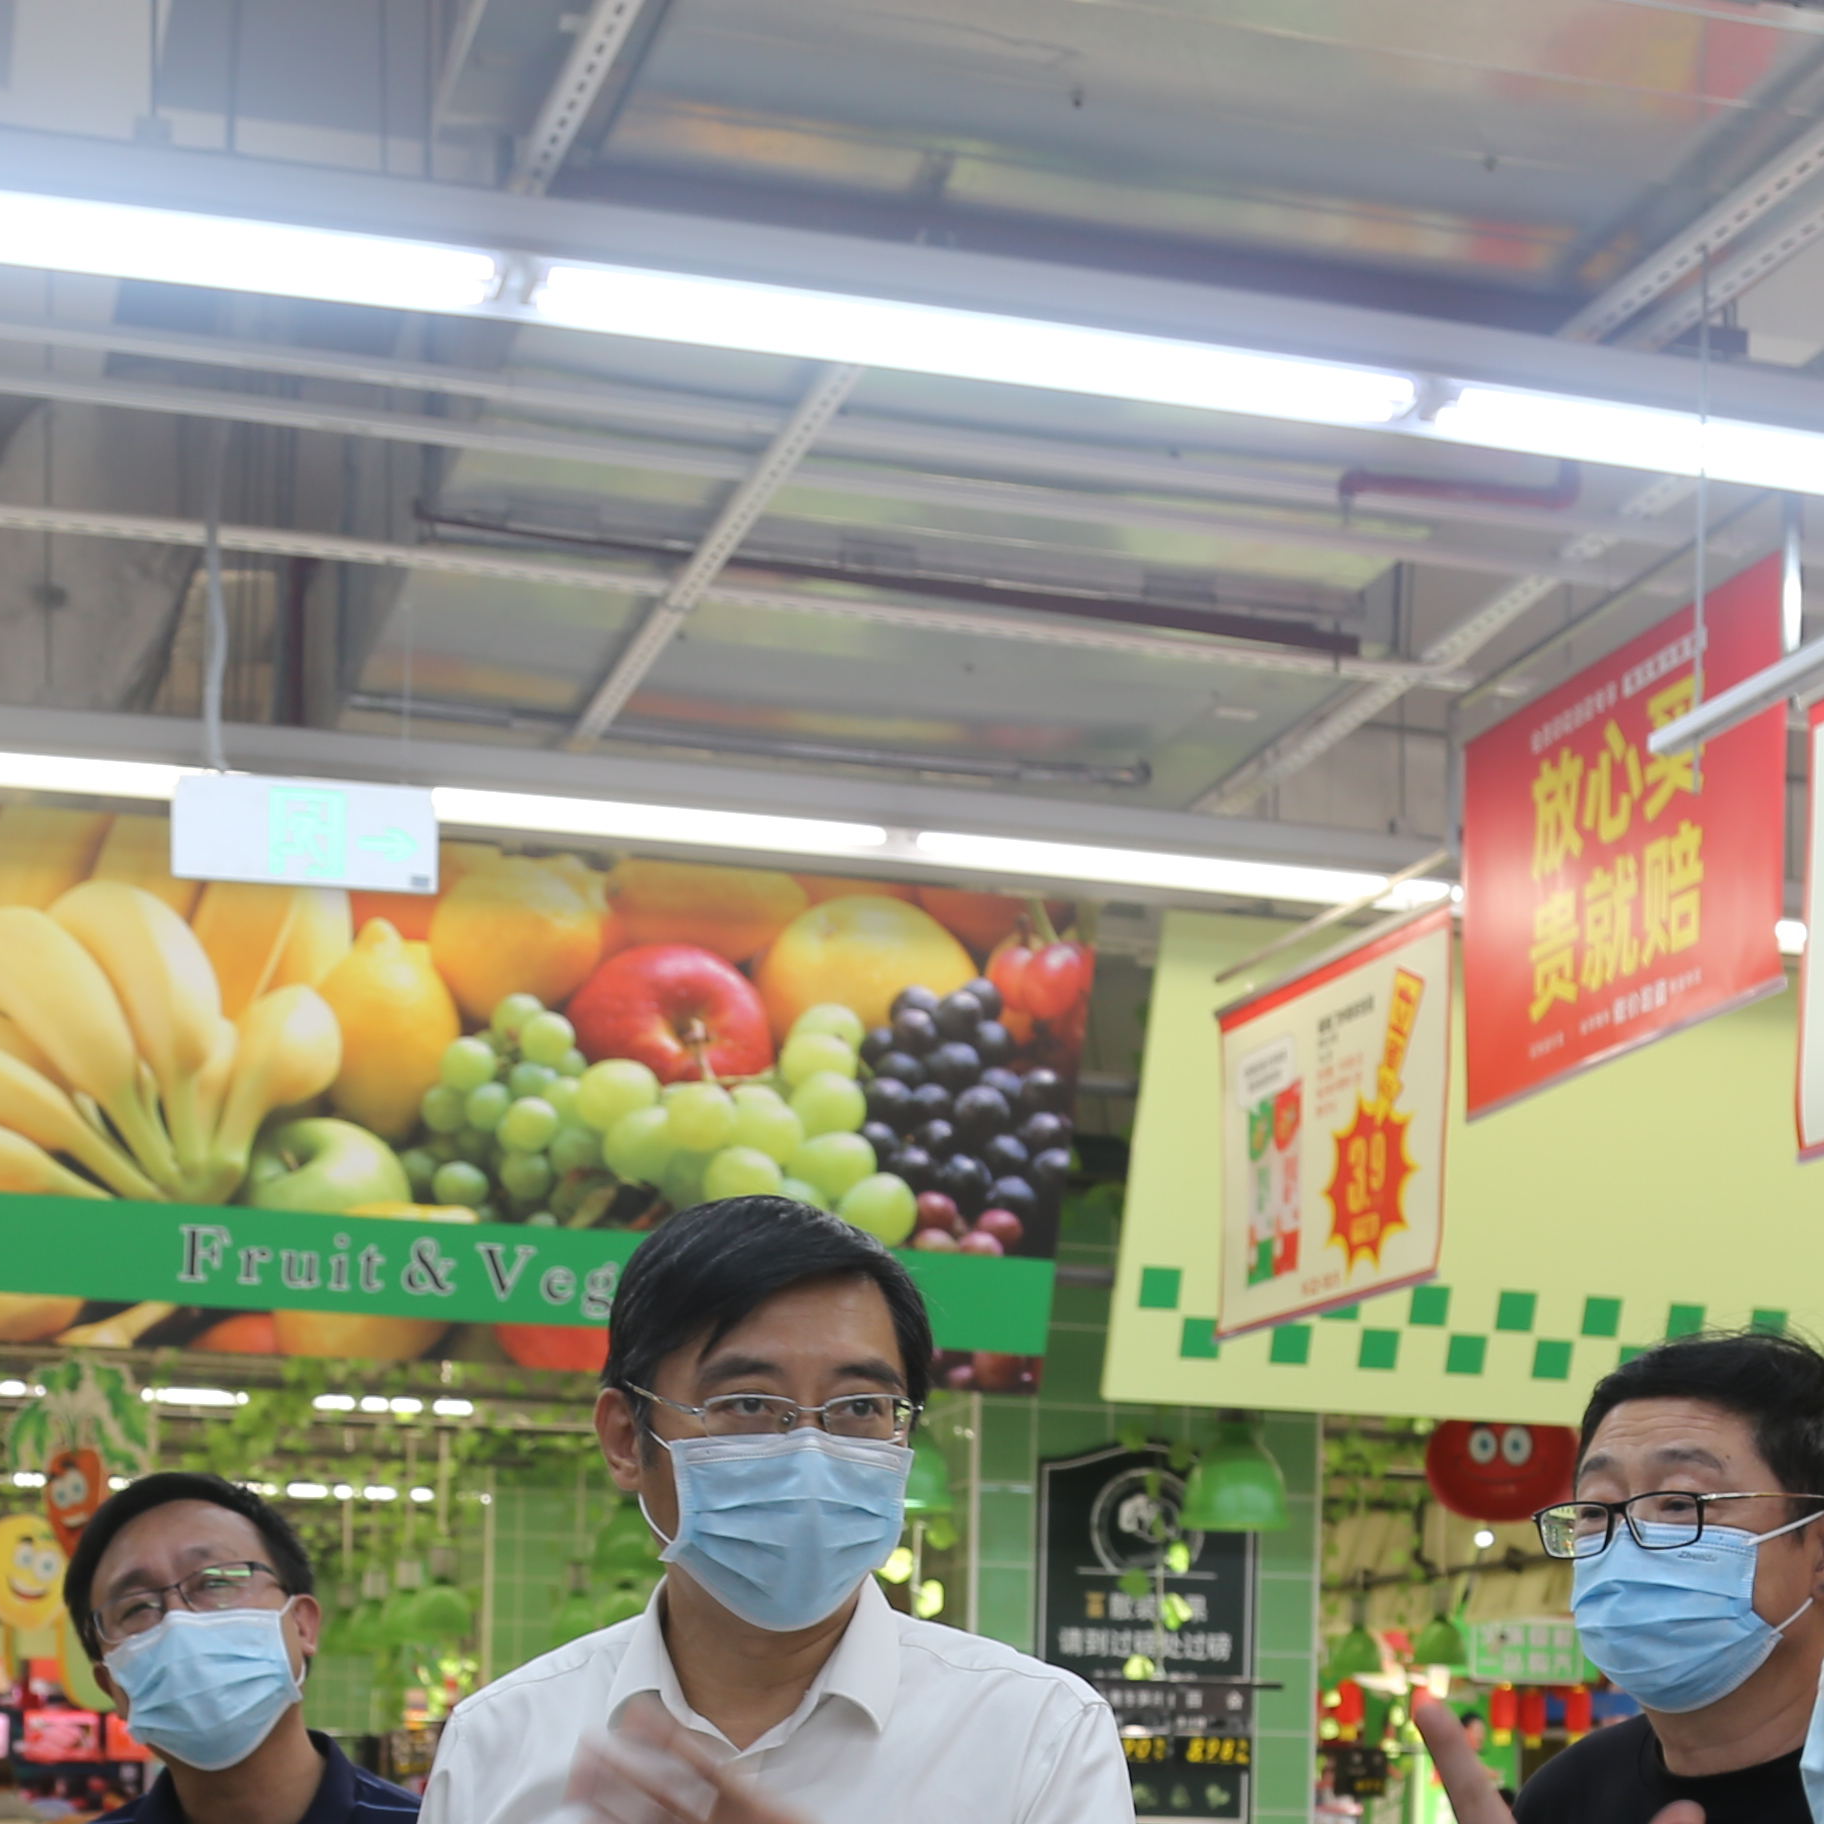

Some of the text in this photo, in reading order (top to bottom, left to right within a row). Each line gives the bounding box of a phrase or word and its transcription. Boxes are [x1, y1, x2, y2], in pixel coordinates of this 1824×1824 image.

[1528, 819, 1704, 1024] 贵就赔
[177, 1224, 620, 1320] Fruit & Veg
